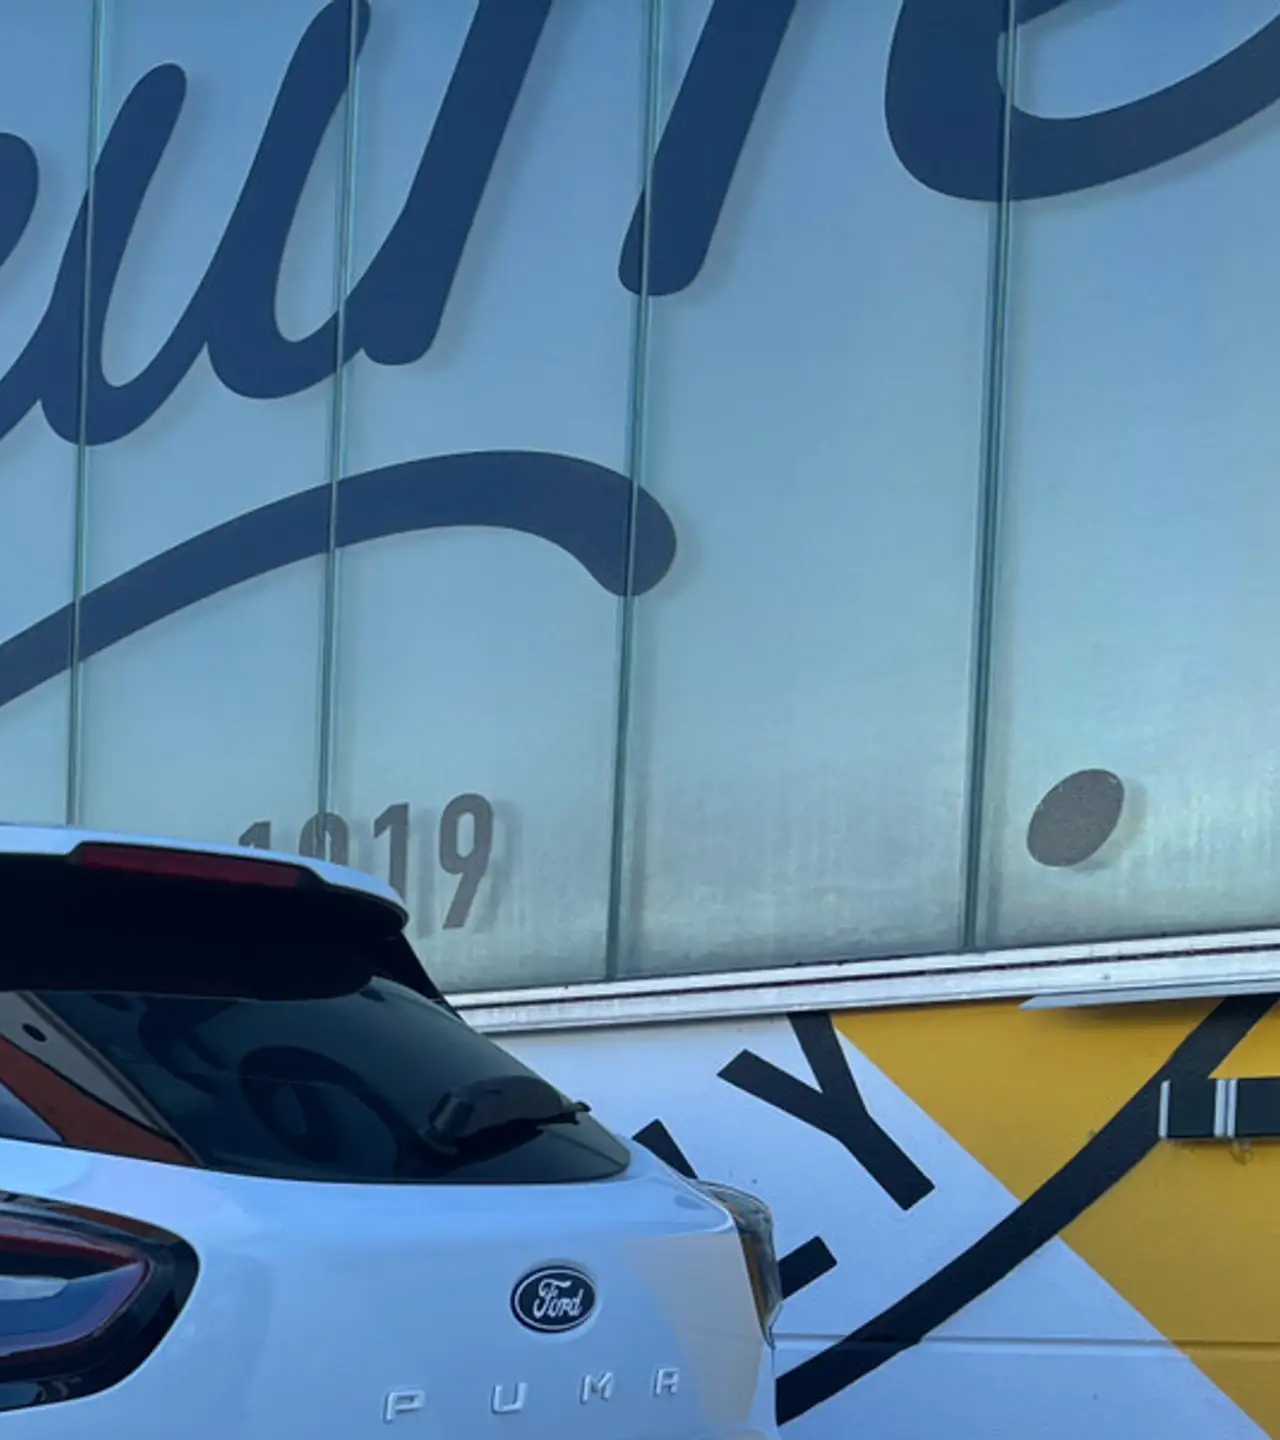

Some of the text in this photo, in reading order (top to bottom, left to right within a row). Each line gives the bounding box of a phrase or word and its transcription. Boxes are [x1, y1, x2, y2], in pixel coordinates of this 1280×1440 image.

[237, 792, 494, 930] 19
[532, 1277, 585, 1320] Ford
[382, 1366, 681, 1424] PUMA
